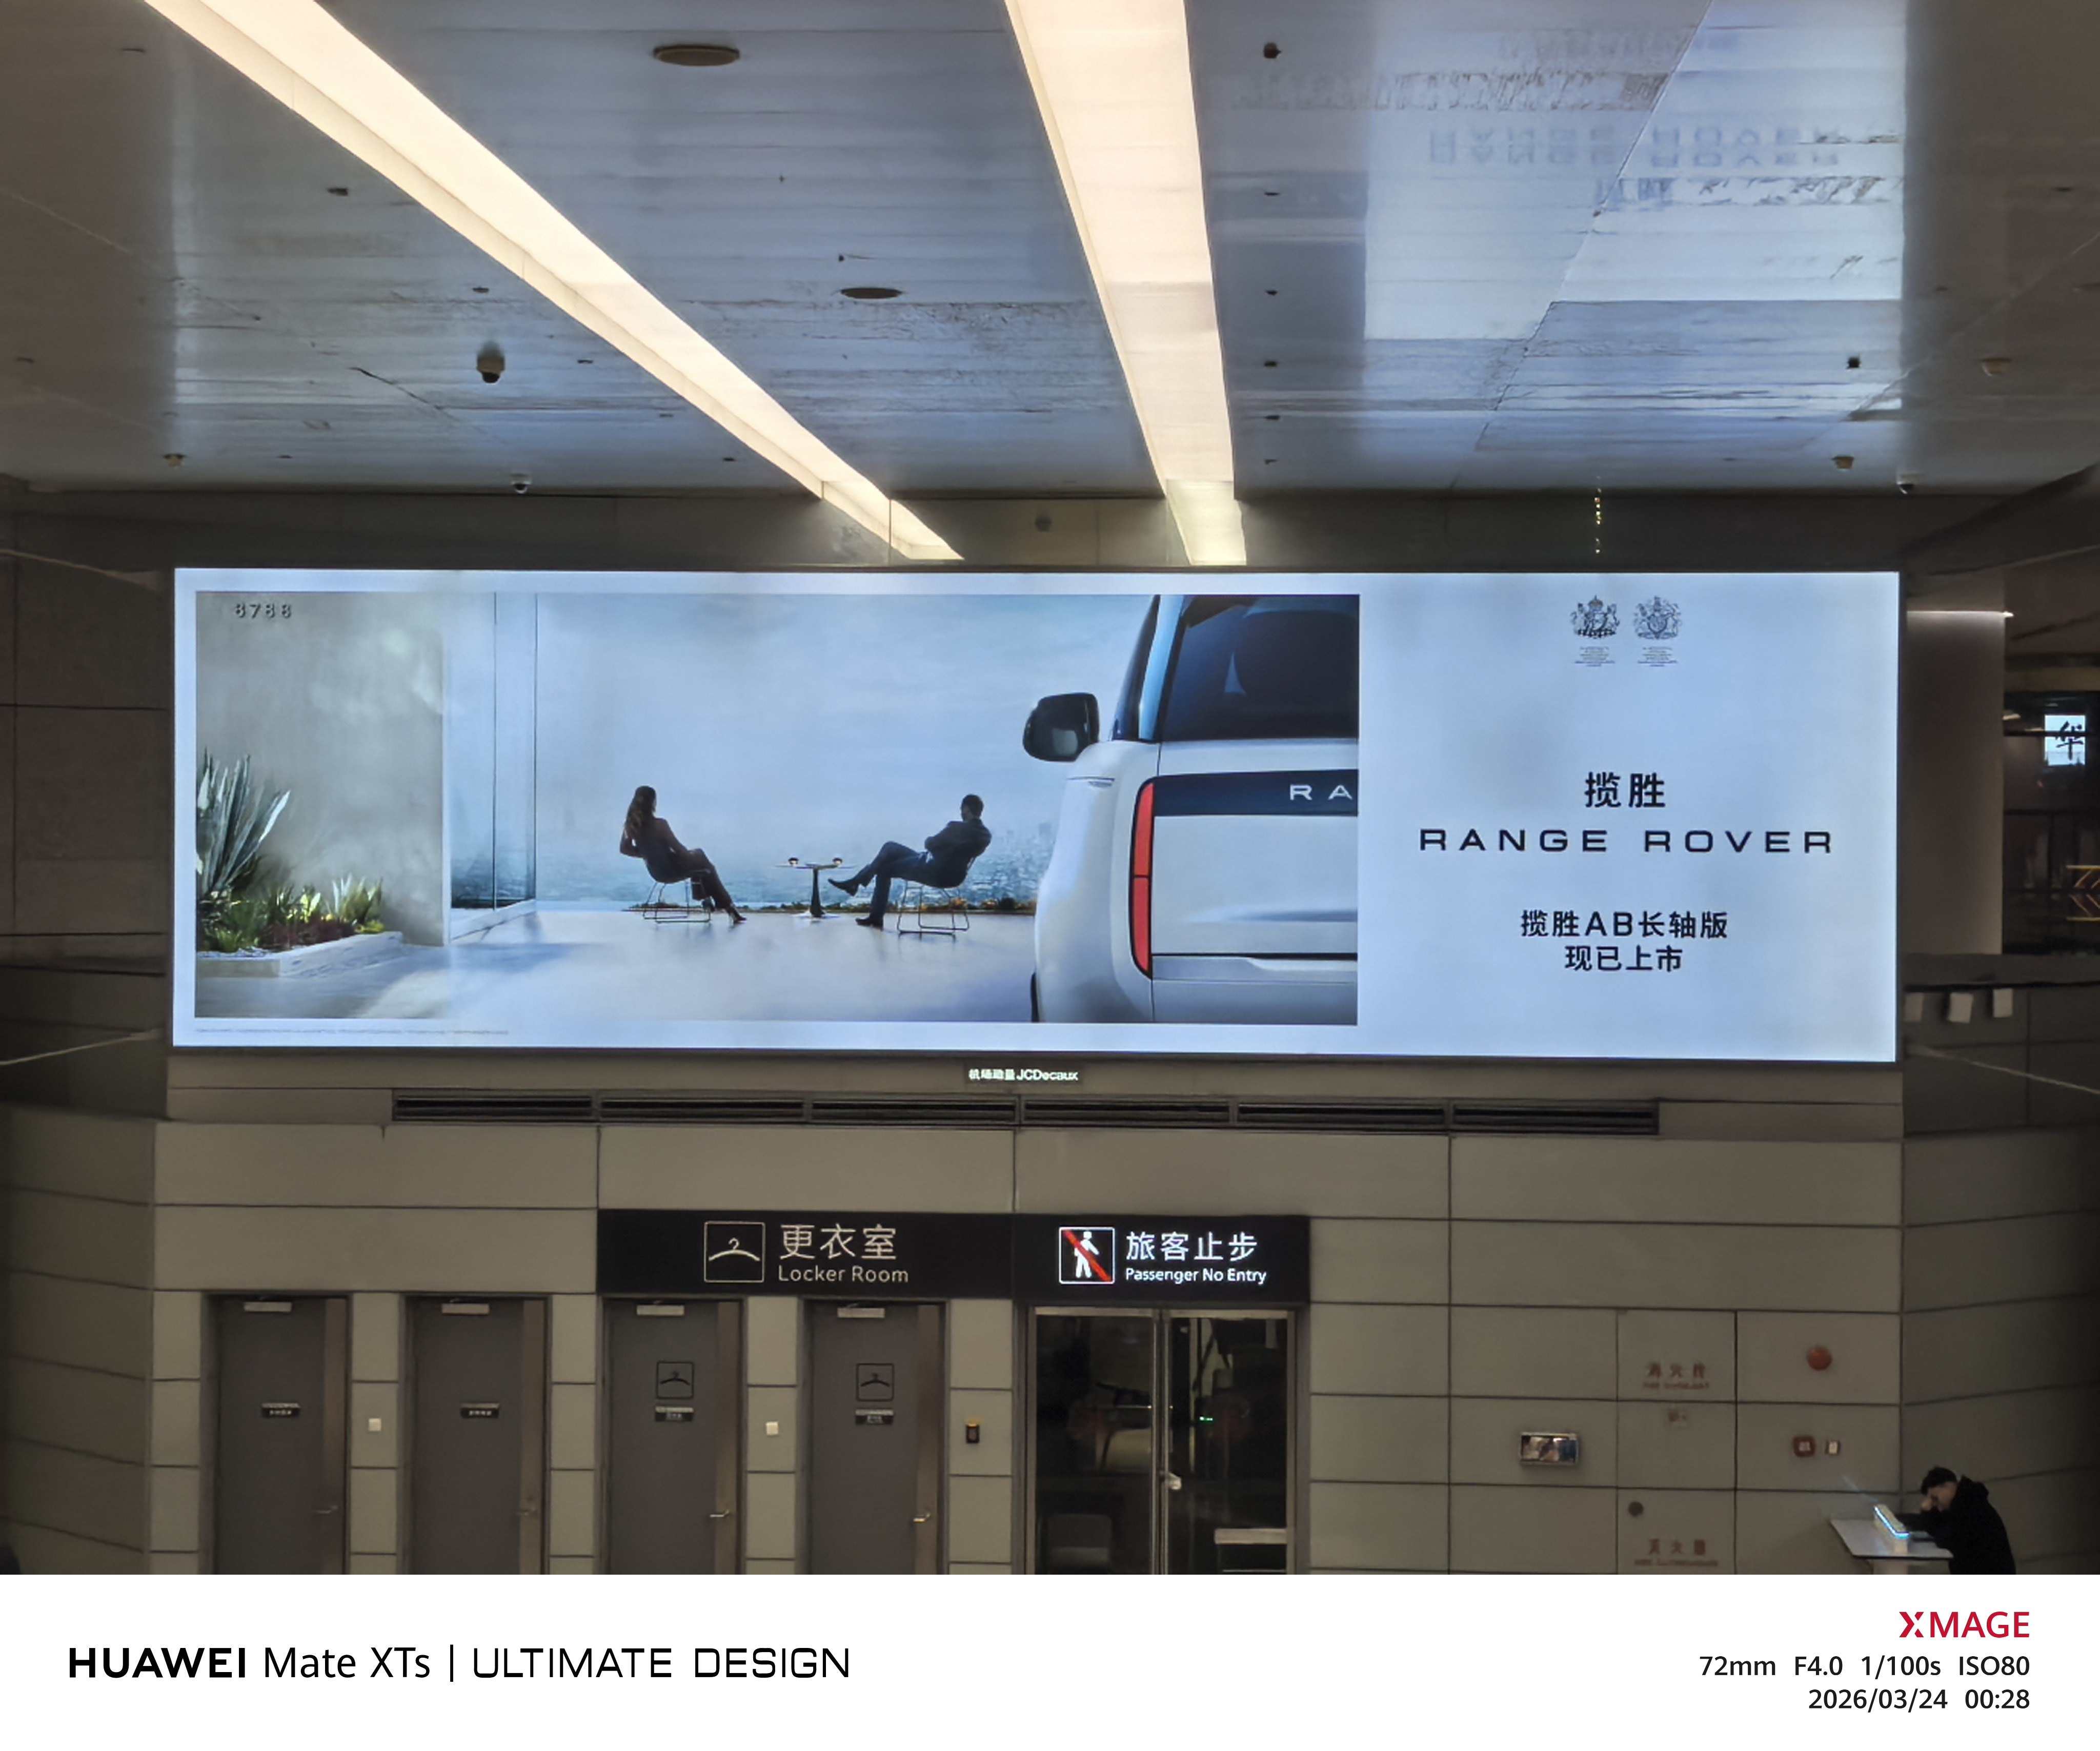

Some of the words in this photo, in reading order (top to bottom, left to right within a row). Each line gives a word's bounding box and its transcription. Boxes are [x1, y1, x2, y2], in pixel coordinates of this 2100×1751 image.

[1289, 784, 1353, 801] RA
[1584, 772, 1666, 808] 揽胜
[1420, 828, 1607, 852] RANGE
[1644, 830, 1830, 853] ROVER
[1521, 909, 1728, 939] 揽胜AB长轴版
[1565, 945, 1683, 972] 现已上市
[1016, 1069, 1078, 1081] JCDecaux
[779, 1223, 897, 1259] 更衣室
[1126, 1231, 1257, 1262] 旅客止步
[778, 1265, 846, 1282] Locker
[852, 1265, 909, 1282] Room
[1125, 1267, 1199, 1285] Passenger
[1203, 1268, 1224, 1282] No
[1227, 1268, 1267, 1285] Entry
